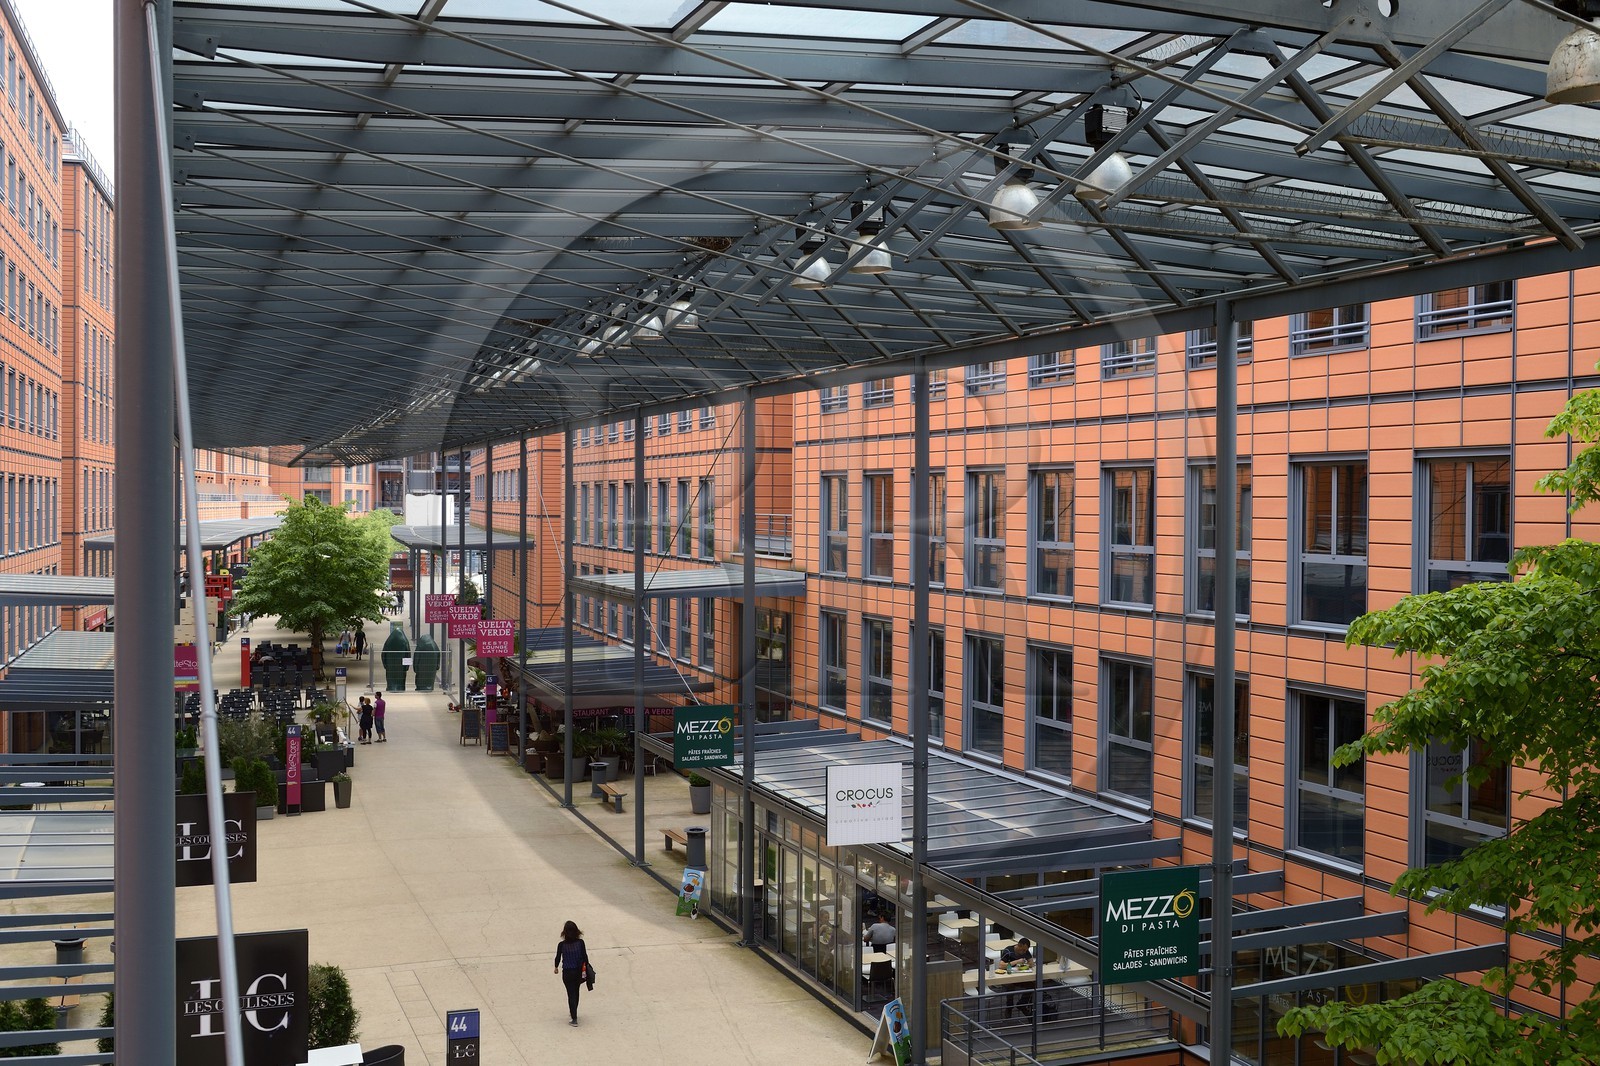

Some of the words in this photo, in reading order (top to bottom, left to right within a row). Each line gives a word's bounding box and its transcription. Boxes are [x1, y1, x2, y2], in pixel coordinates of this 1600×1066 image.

[573, 708, 609, 717] STAURANT
[677, 717, 732, 734] MEZZO
[836, 788, 893, 801] CROCUS
[1106, 888, 1196, 922] MEZZO
[1122, 924, 1134, 933] DI
[1142, 920, 1179, 931] PASTA
[1124, 949, 1144, 958] PÂTES
[1146, 946, 1177, 957] FRAÎCHES
[1113, 961, 1142, 970] SALADES
[1150, 956, 1188, 966] SANDWICHS
[184, 1001, 212, 1014] LES
[451, 1016, 467, 1032] 44
